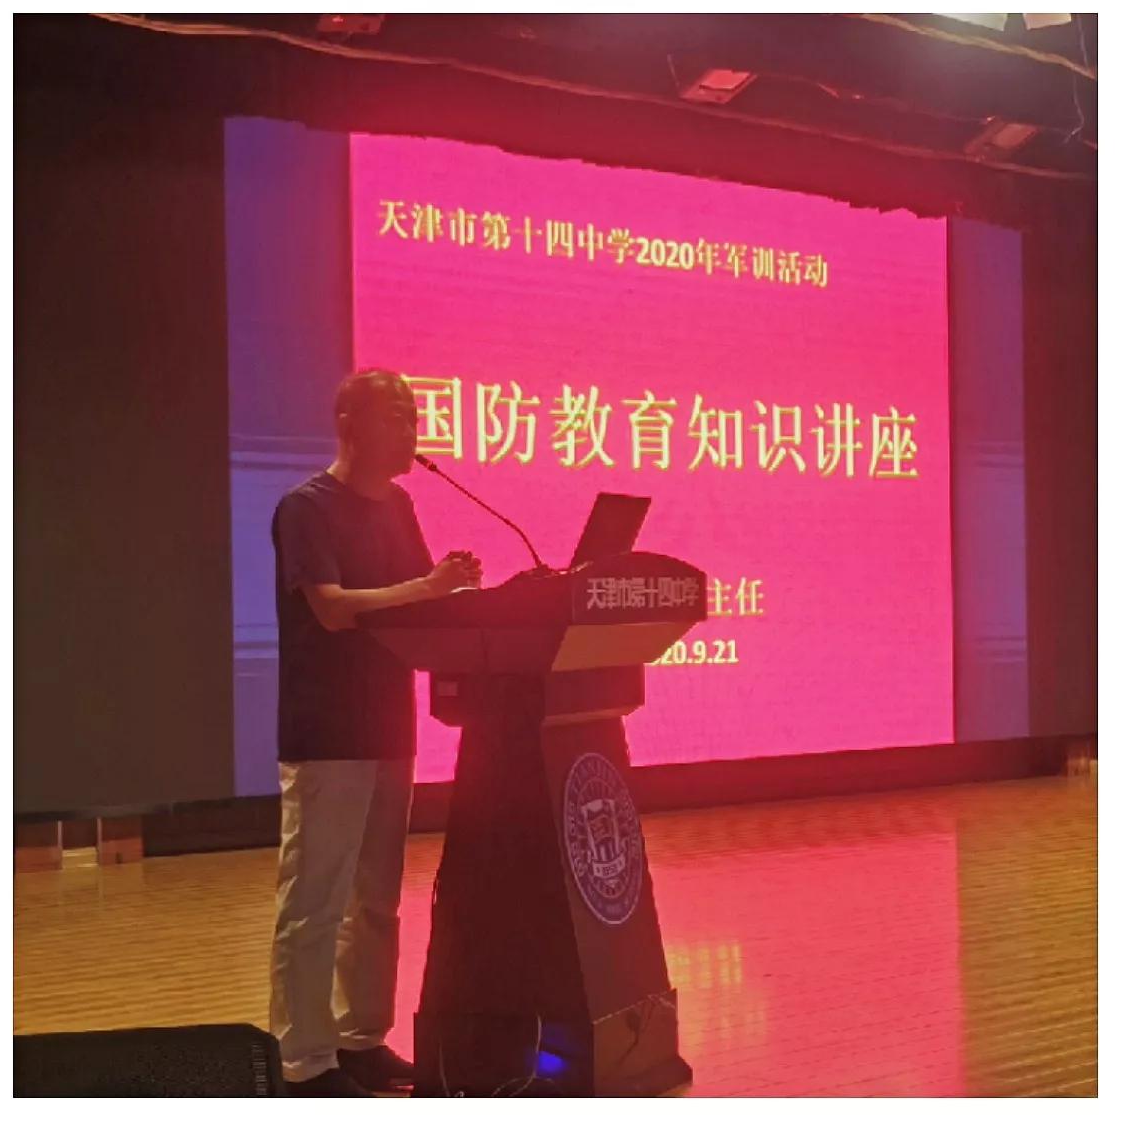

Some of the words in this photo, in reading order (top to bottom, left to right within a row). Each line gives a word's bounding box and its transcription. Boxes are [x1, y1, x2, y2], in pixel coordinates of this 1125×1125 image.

[378, 200, 829, 287] 天津市第十四中学2020年军训活动
[401, 375, 919, 479] 国防教育知识讲座
[586, 577, 699, 609] 天津市第十四中学
[707, 577, 764, 616] 主任
[651, 639, 739, 665] 20.9.21
